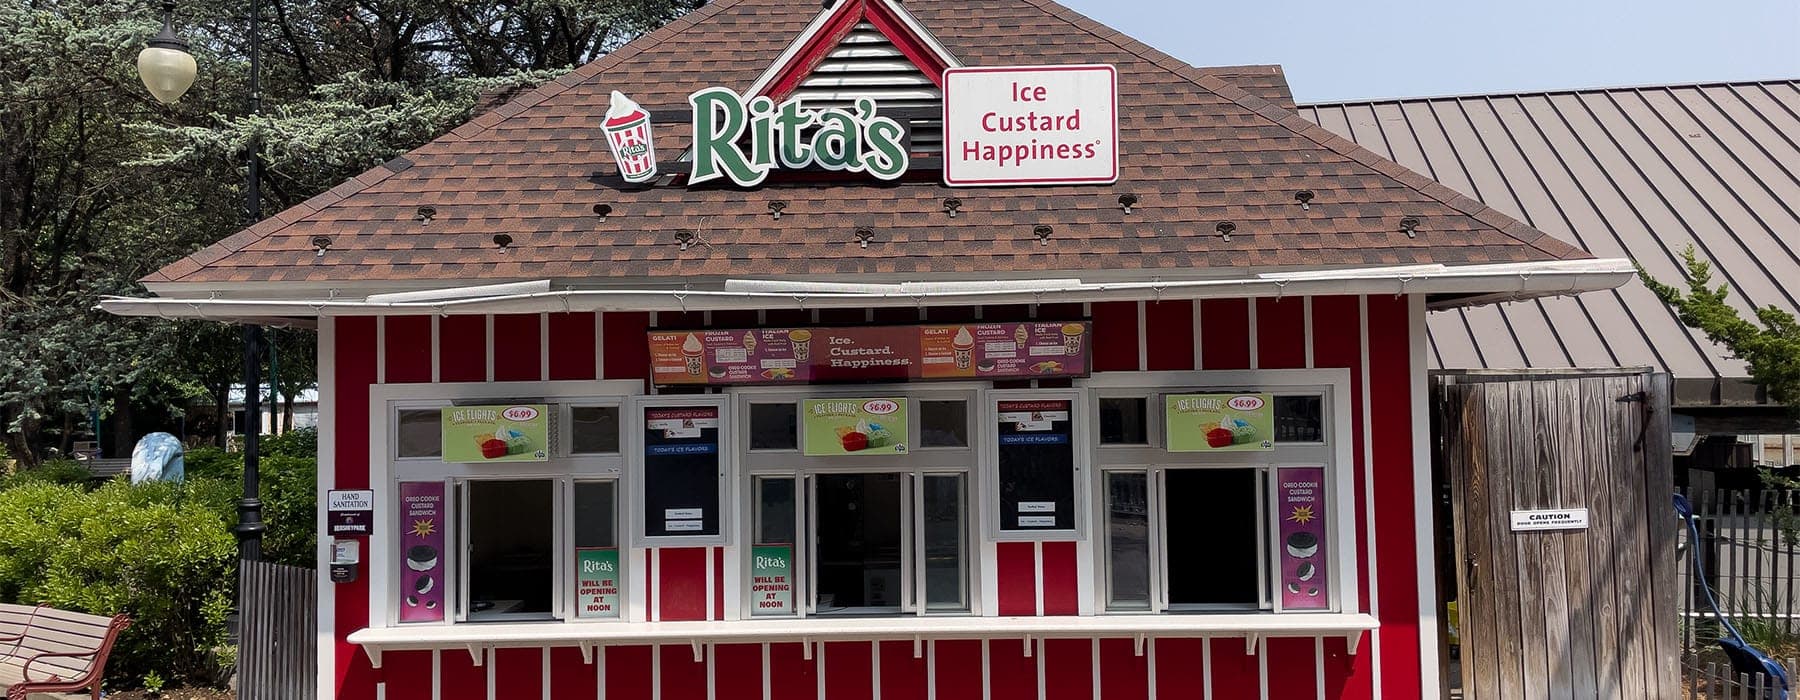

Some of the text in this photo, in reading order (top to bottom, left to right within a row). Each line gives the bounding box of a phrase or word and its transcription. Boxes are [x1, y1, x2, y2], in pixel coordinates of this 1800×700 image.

[1012, 82, 1047, 102] Ice
[981, 109, 1081, 132] Custard
[690, 88, 906, 184] Rita's
[829, 336, 856, 345] Ice.
[830, 346, 895, 356] Custard.
[830, 358, 913, 369] Happiness.
[870, 403, 893, 411] $6.99
[1178, 398, 1222, 411] ICE FLIGHTS
[1233, 399, 1258, 408] $6.99
[813, 402, 857, 415] ICE FLIGHTS
[452, 408, 497, 422] ICE FLIGHTS
[508, 410, 532, 419] $6.99
[342, 493, 360, 501] HAND
[333, 501, 369, 509] SANITATION
[583, 559, 614, 573] Rita's
[756, 556, 786, 569] Rita's
[580, 588, 617, 596] OPENING
[752, 584, 790, 592] OPENING
[765, 592, 777, 600] AT
[587, 604, 611, 612] NOON
